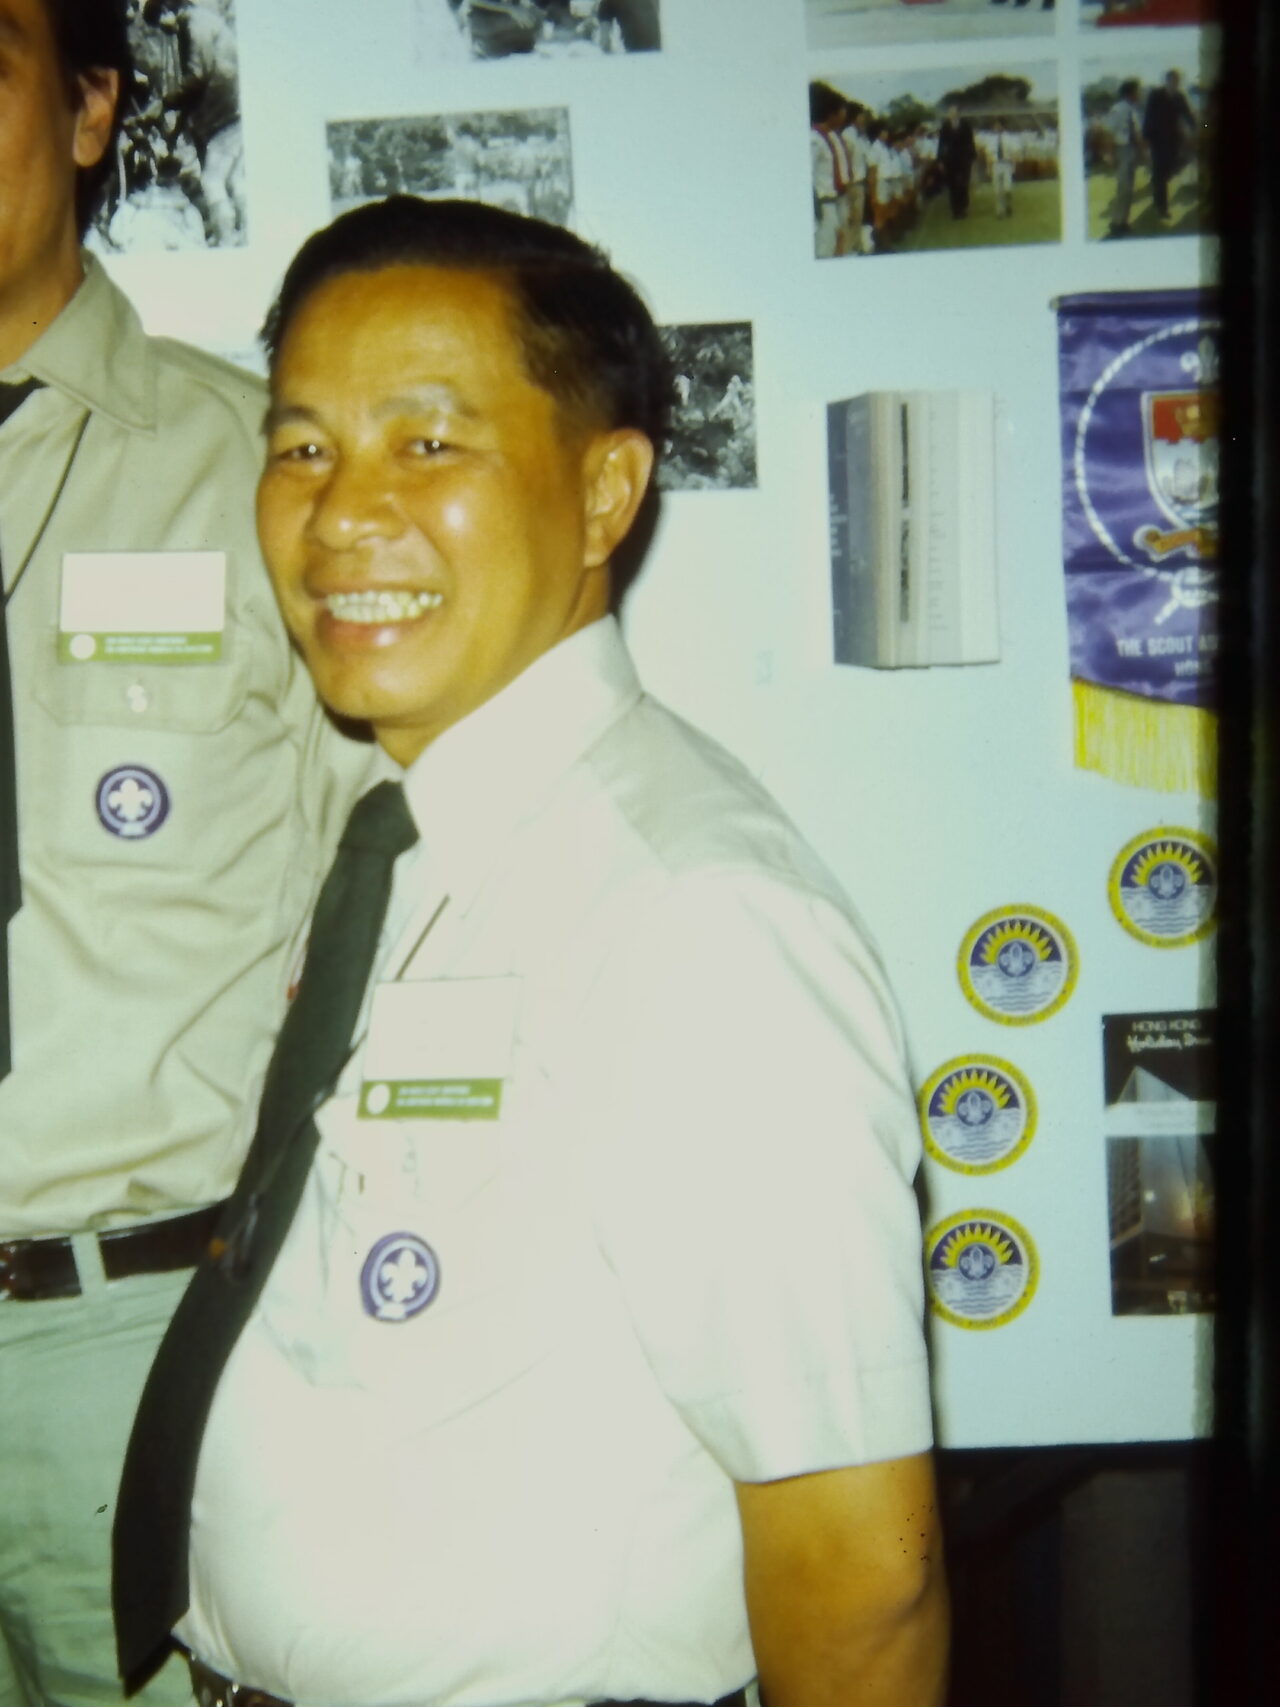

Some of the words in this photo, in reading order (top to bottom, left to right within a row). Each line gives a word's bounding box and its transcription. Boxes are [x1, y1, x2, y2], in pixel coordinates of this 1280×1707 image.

[1117, 638, 1144, 657] THE
[1147, 635, 1194, 656] SCOUT
[1132, 1020, 1167, 1032] HONG
